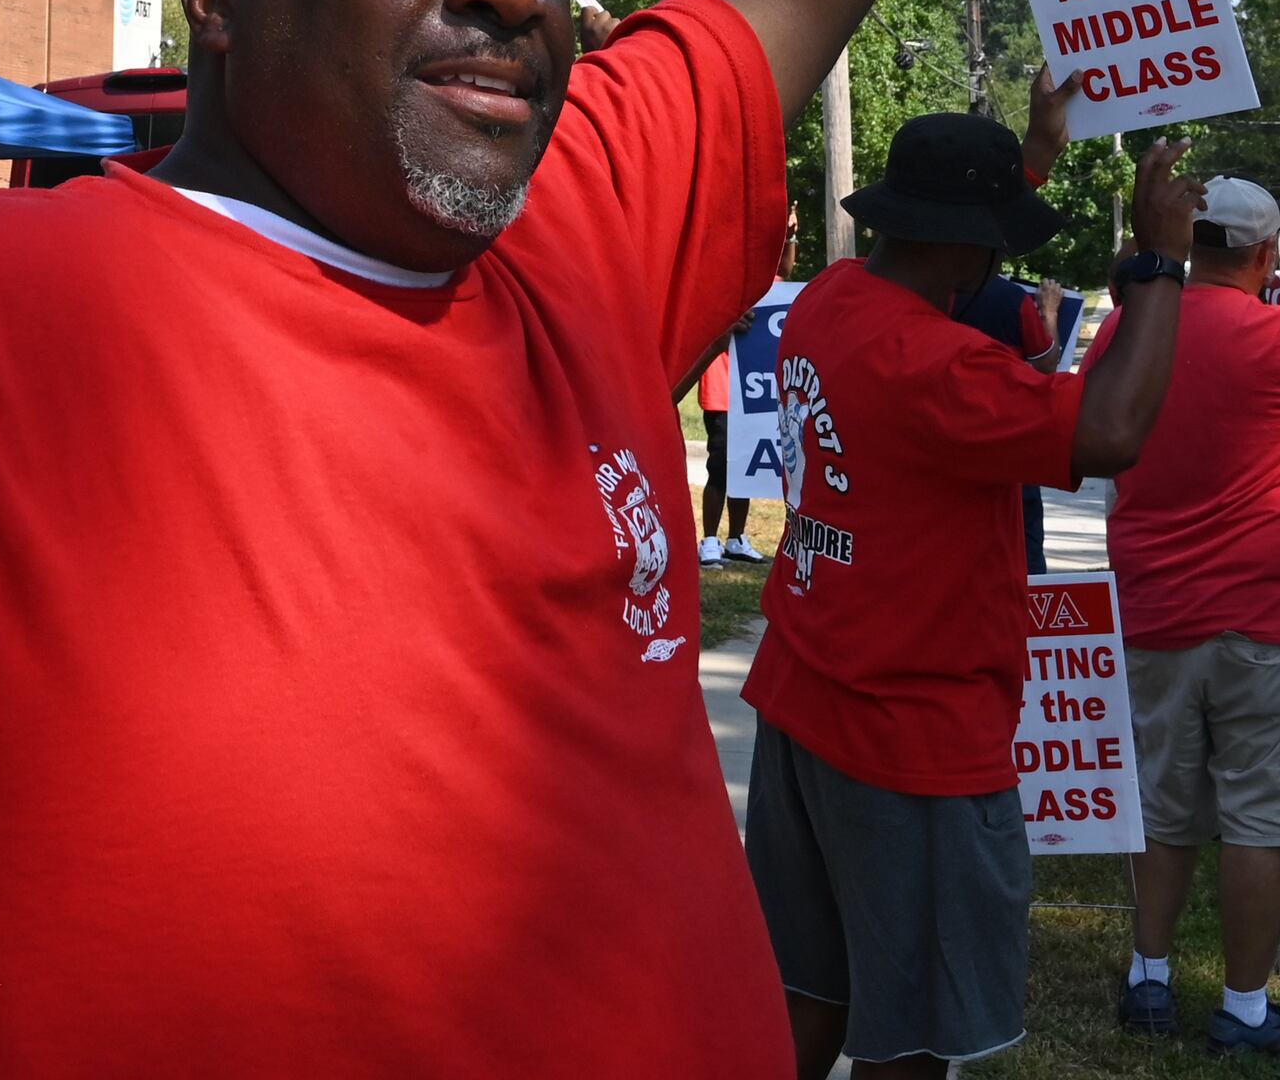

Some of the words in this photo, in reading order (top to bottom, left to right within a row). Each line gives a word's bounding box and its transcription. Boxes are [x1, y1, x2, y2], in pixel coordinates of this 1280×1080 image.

[135, 0, 152, 19] AT&T
[1081, 45, 1222, 102] CLASS
[782, 355, 843, 454] DISTRICT
[824, 465, 848, 493] 3
[798, 513, 854, 566] MORE
[622, 596, 655, 637] LOCAL
[1040, 689, 1107, 723] the
[1013, 737, 1123, 774] DDLE
[1023, 786, 1118, 823] ASS
